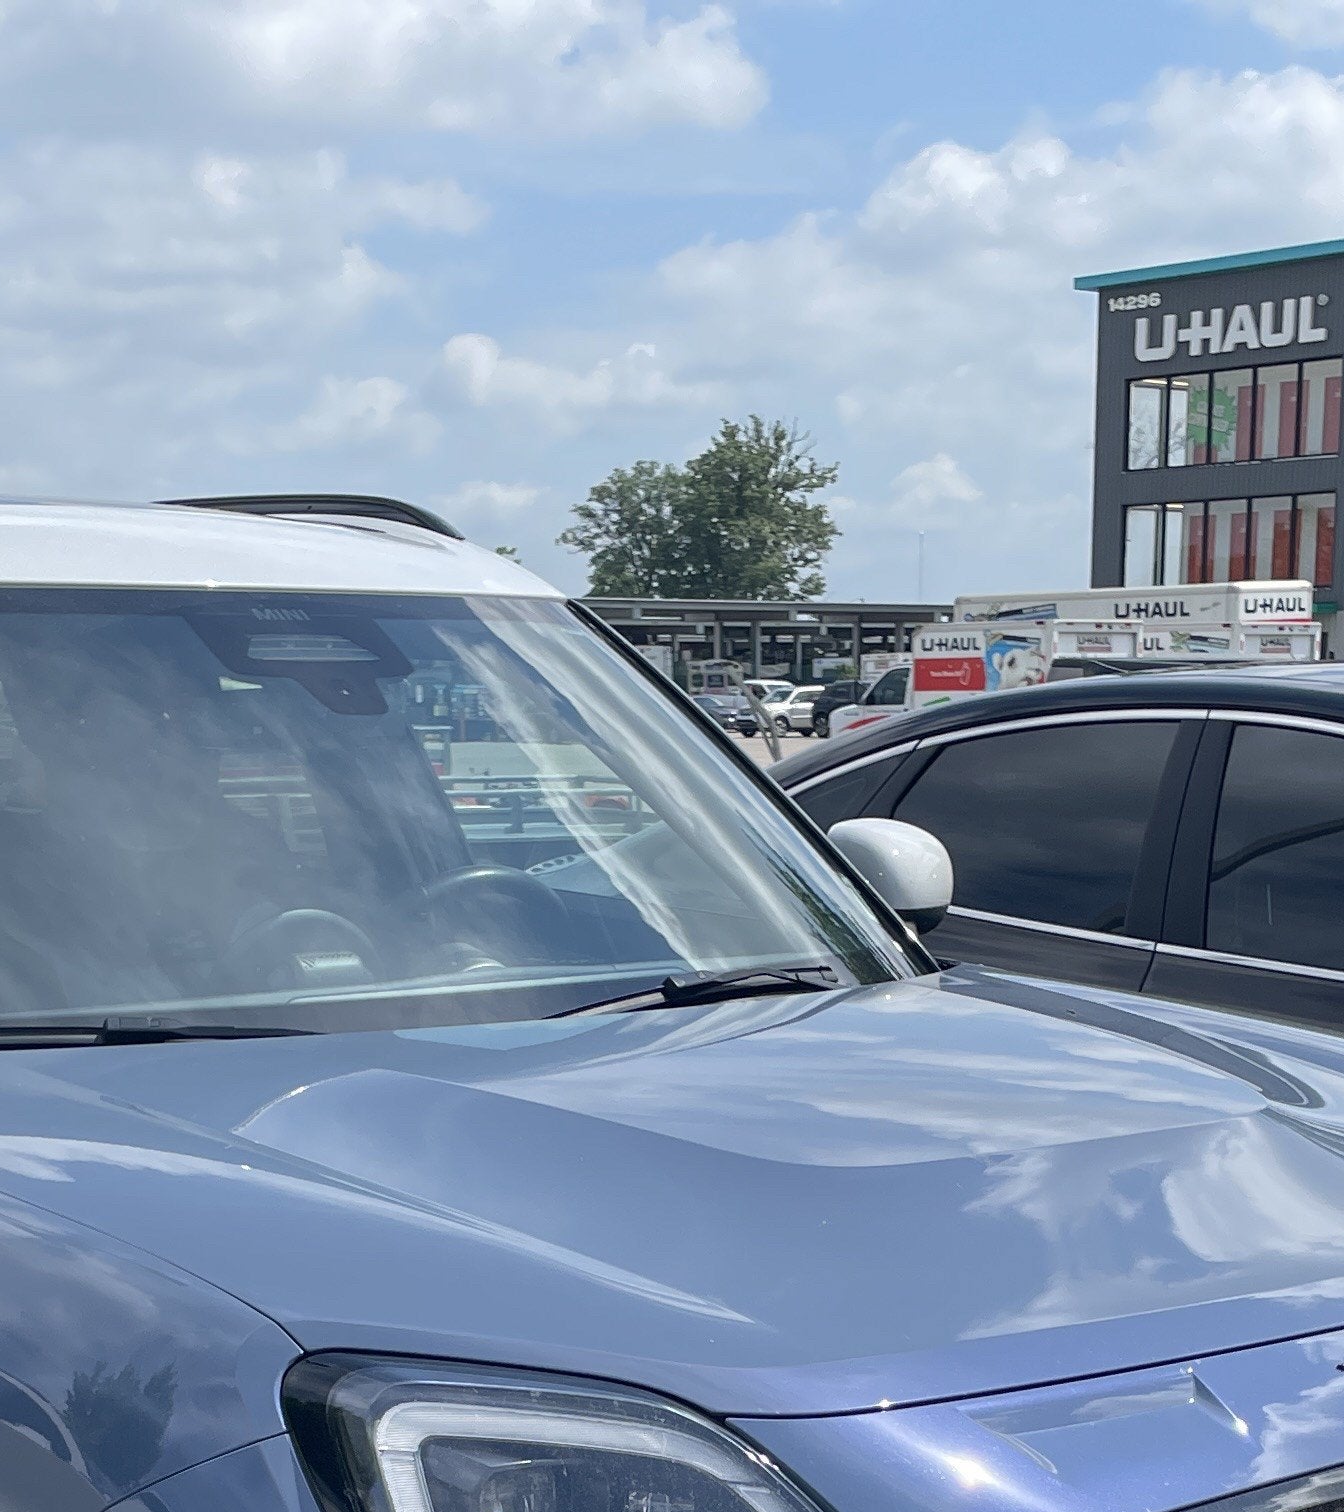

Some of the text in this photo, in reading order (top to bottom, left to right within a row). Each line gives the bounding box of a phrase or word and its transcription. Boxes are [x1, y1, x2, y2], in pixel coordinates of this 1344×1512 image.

[1107, 292, 1162, 313] 14296
[1134, 295, 1328, 362] U-HAUL
[1114, 601, 1190, 619] U-HAUL
[1245, 597, 1306, 614] U-HAUL
[250, 608, 311, 621] MINI
[920, 637, 982, 652] U-HAUL
